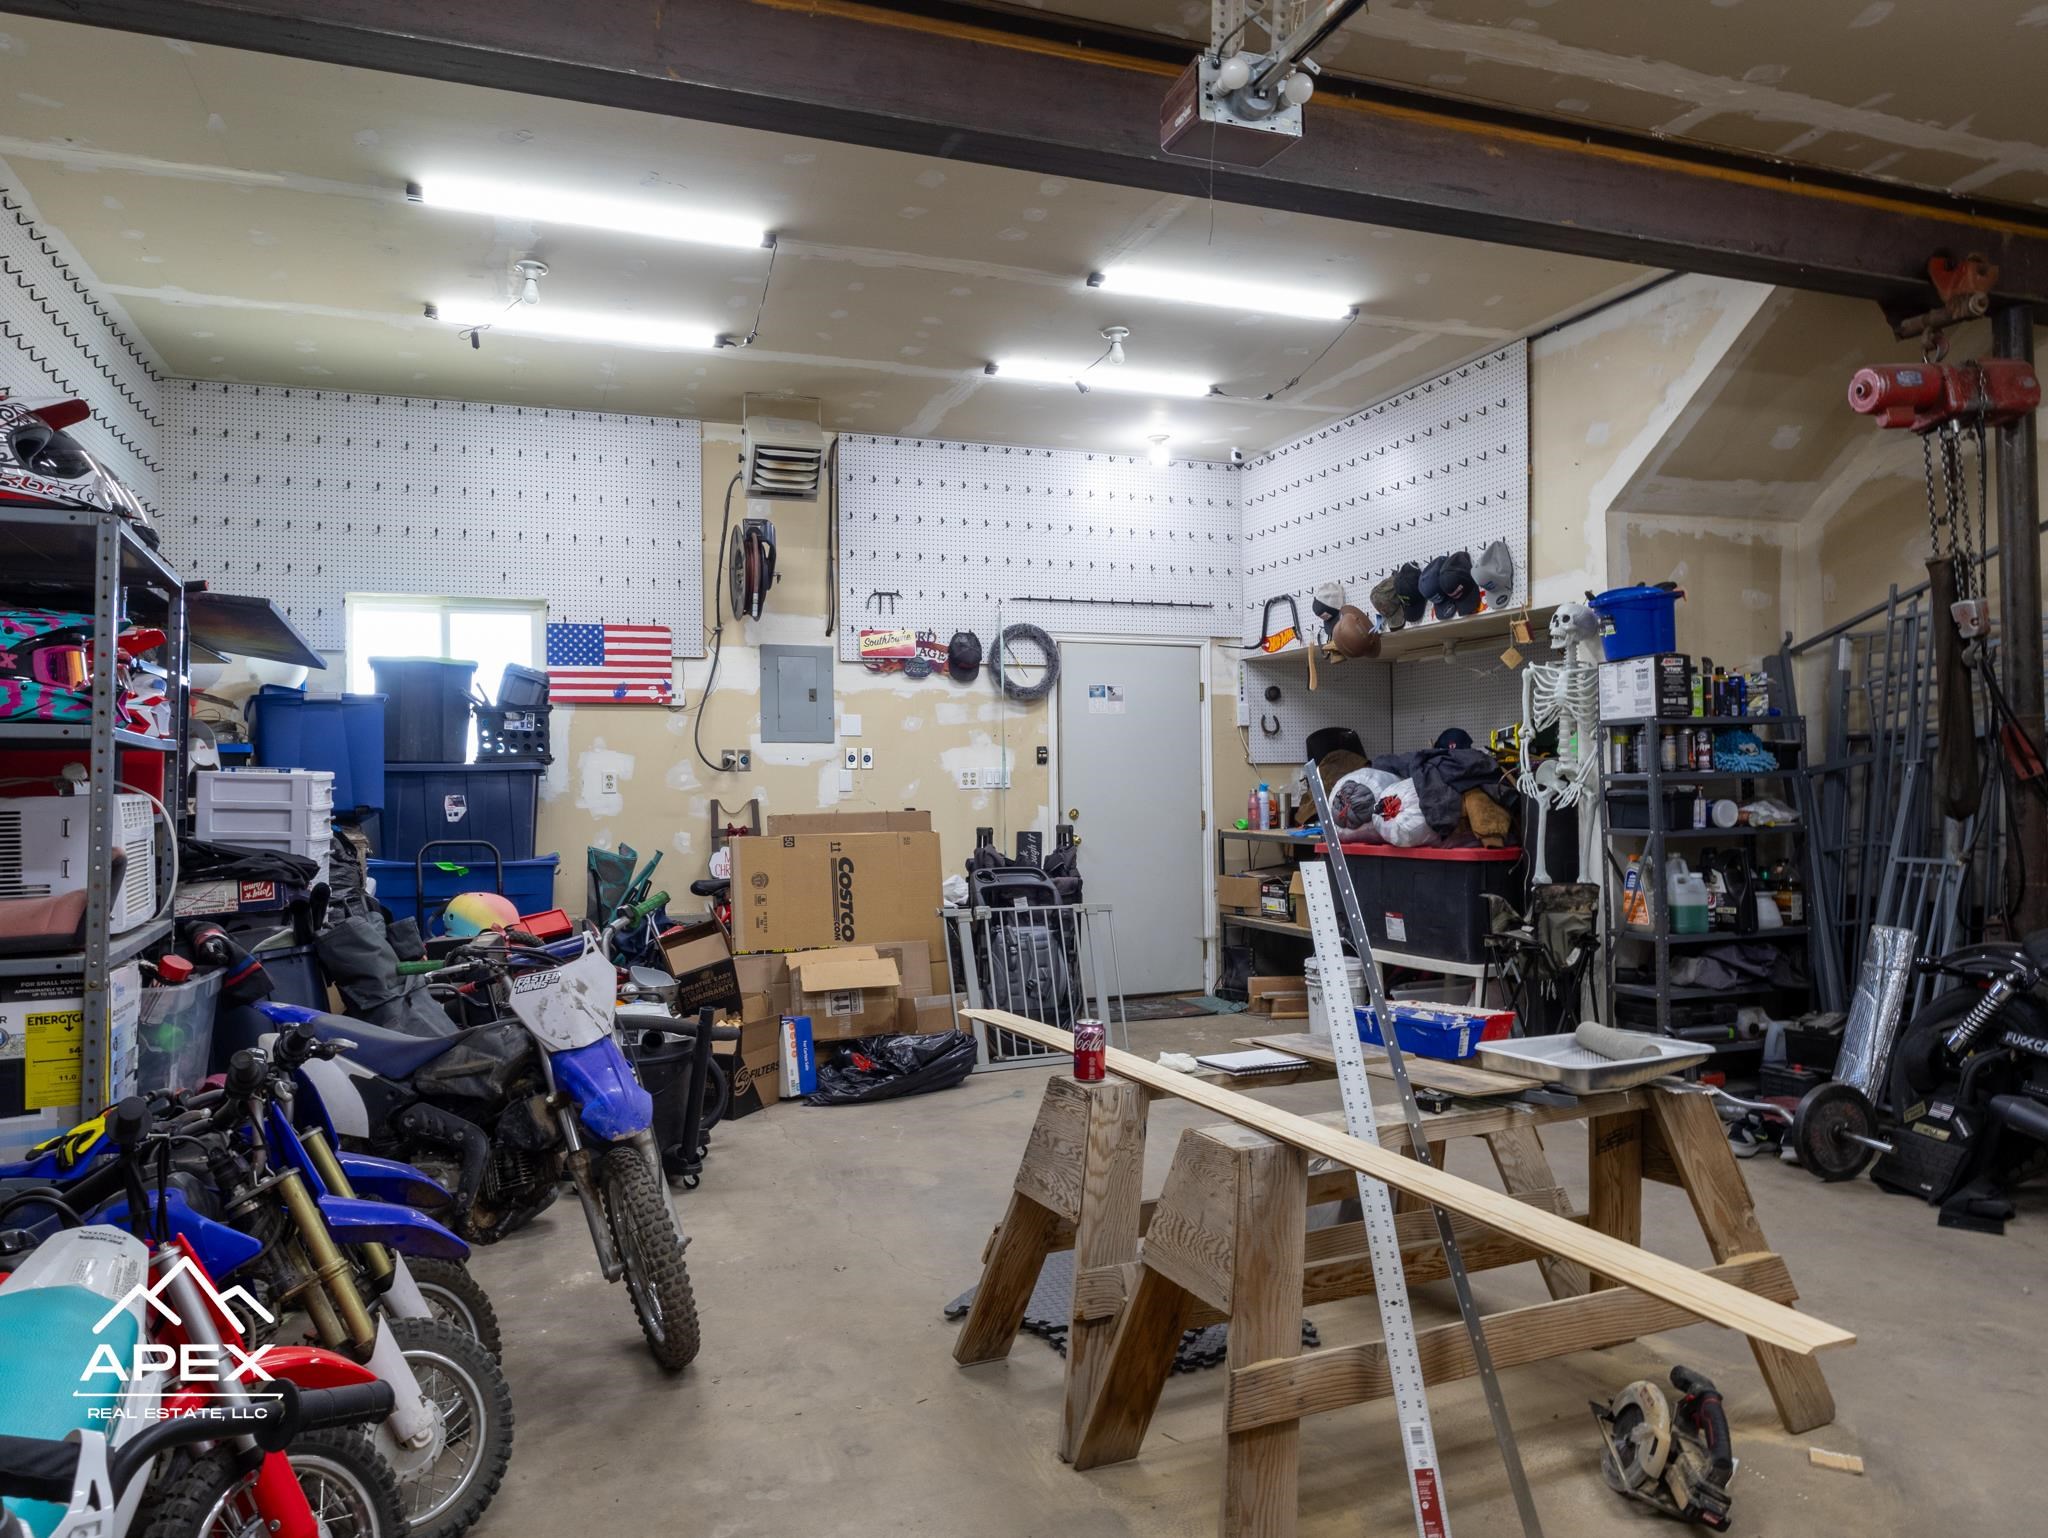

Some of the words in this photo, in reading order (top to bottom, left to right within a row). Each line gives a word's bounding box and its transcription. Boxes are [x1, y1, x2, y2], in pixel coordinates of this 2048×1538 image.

[838, 856, 855, 942] COSTCO
[515, 971, 561, 987] FASTER
[516, 980, 549, 993] MINIS
[27, 1013, 84, 1027] ENERGYG
[1075, 1030, 1104, 1052] Cola
[750, 1060, 780, 1078] FILTERS
